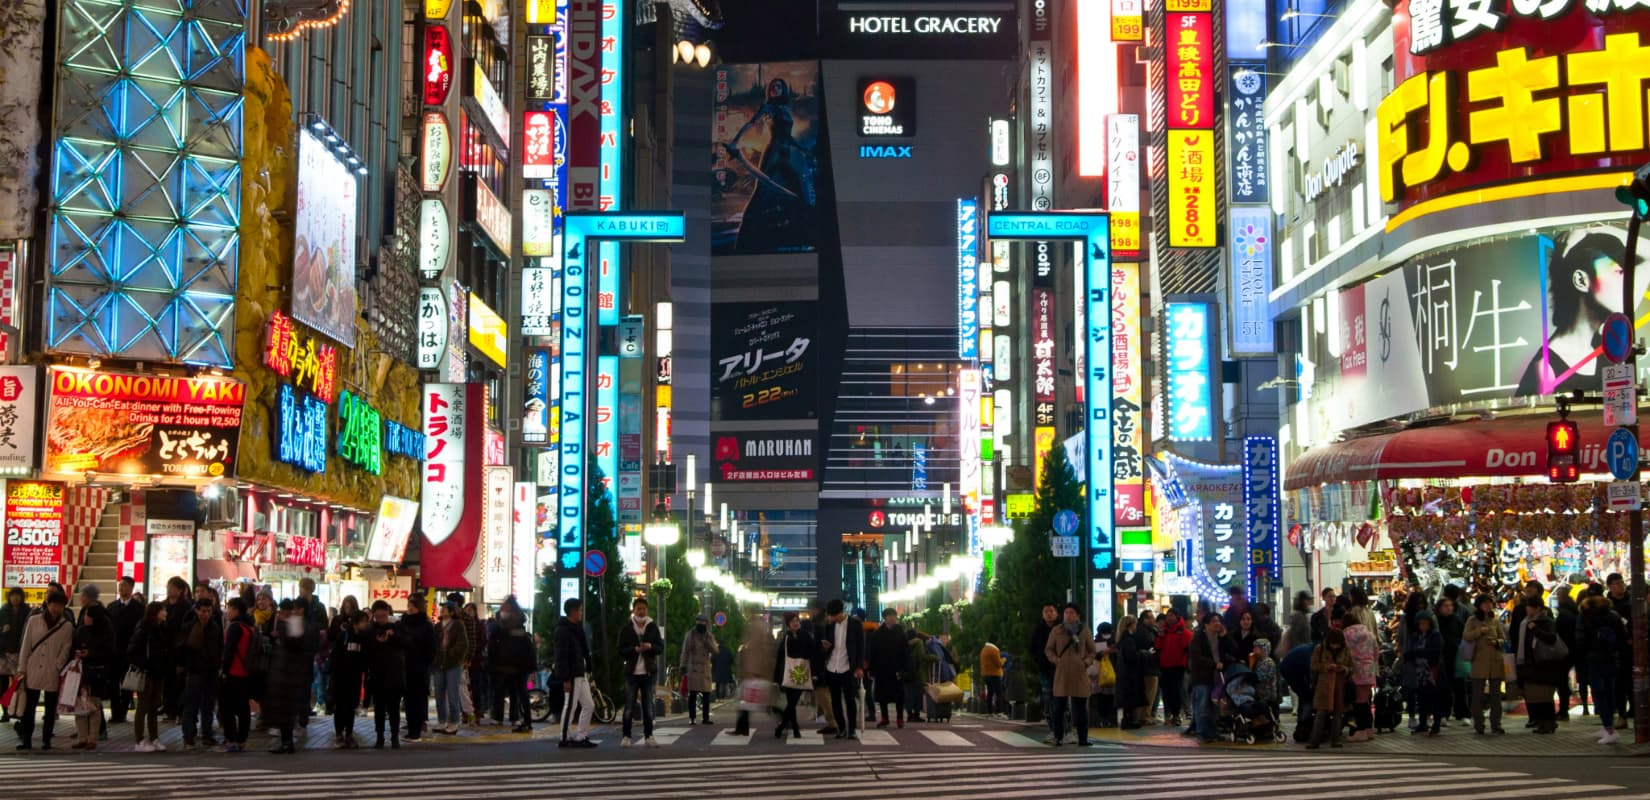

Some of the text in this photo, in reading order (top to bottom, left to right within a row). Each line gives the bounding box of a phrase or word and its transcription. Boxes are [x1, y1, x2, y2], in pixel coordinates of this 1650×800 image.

[850, 17, 1001, 33] HOTEL GRACERY
[1181, 16, 1197, 27] 5F
[1176, 29, 1201, 125] 豊後高田どり
[863, 116, 892, 126] TOHO
[1037, 109, 1046, 117] &
[863, 125, 903, 135] CINEMAS
[860, 146, 912, 158] IMAX
[1234, 97, 1253, 196] かんかん商店
[1180, 149, 1204, 183] 酒場
[1305, 140, 1357, 203] Don Quijote
[573, 182, 594, 211] BI
[994, 220, 1089, 230] CENTRAL ROAD
[1185, 195, 1200, 237] 280
[1036, 241, 1050, 277] ooth
[1242, 321, 1264, 336] 5F
[1411, 257, 1533, 395] 桐生
[719, 337, 810, 383] アリータ
[1174, 307, 1207, 434] カラオケ
[57, 373, 243, 401] OKONOMI YAKI
[528, 354, 543, 395] 海の家
[4, 378, 16, 397] 旨
[563, 265, 582, 518] GODZILLA ROAD
[742, 386, 782, 408] 2.22
[1091, 287, 1107, 501] ゴジラロード
[55, 398, 132, 411] All-You-Can-Eat
[131, 401, 160, 412] dinner
[163, 403, 182, 413] with
[450, 386, 463, 440] 大衆酒場
[1037, 402, 1053, 413] 4F
[130, 412, 159, 424] Drinks
[161, 413, 174, 424] for
[175, 415, 181, 424] 2
[183, 415, 209, 425] hours
[1037, 413, 1053, 424] 3F
[427, 392, 448, 483] トラノコ
[745, 439, 812, 457] MARUHAN
[1113, 397, 1142, 480] 金の蔵
[1486, 448, 1537, 468] Don
[1250, 443, 1273, 544] カラオケ
[888, 513, 922, 526] TOHO
[1214, 502, 1237, 585] カラオケ
[1252, 549, 1273, 564] B1
[373, 589, 409, 599] トラノコ
